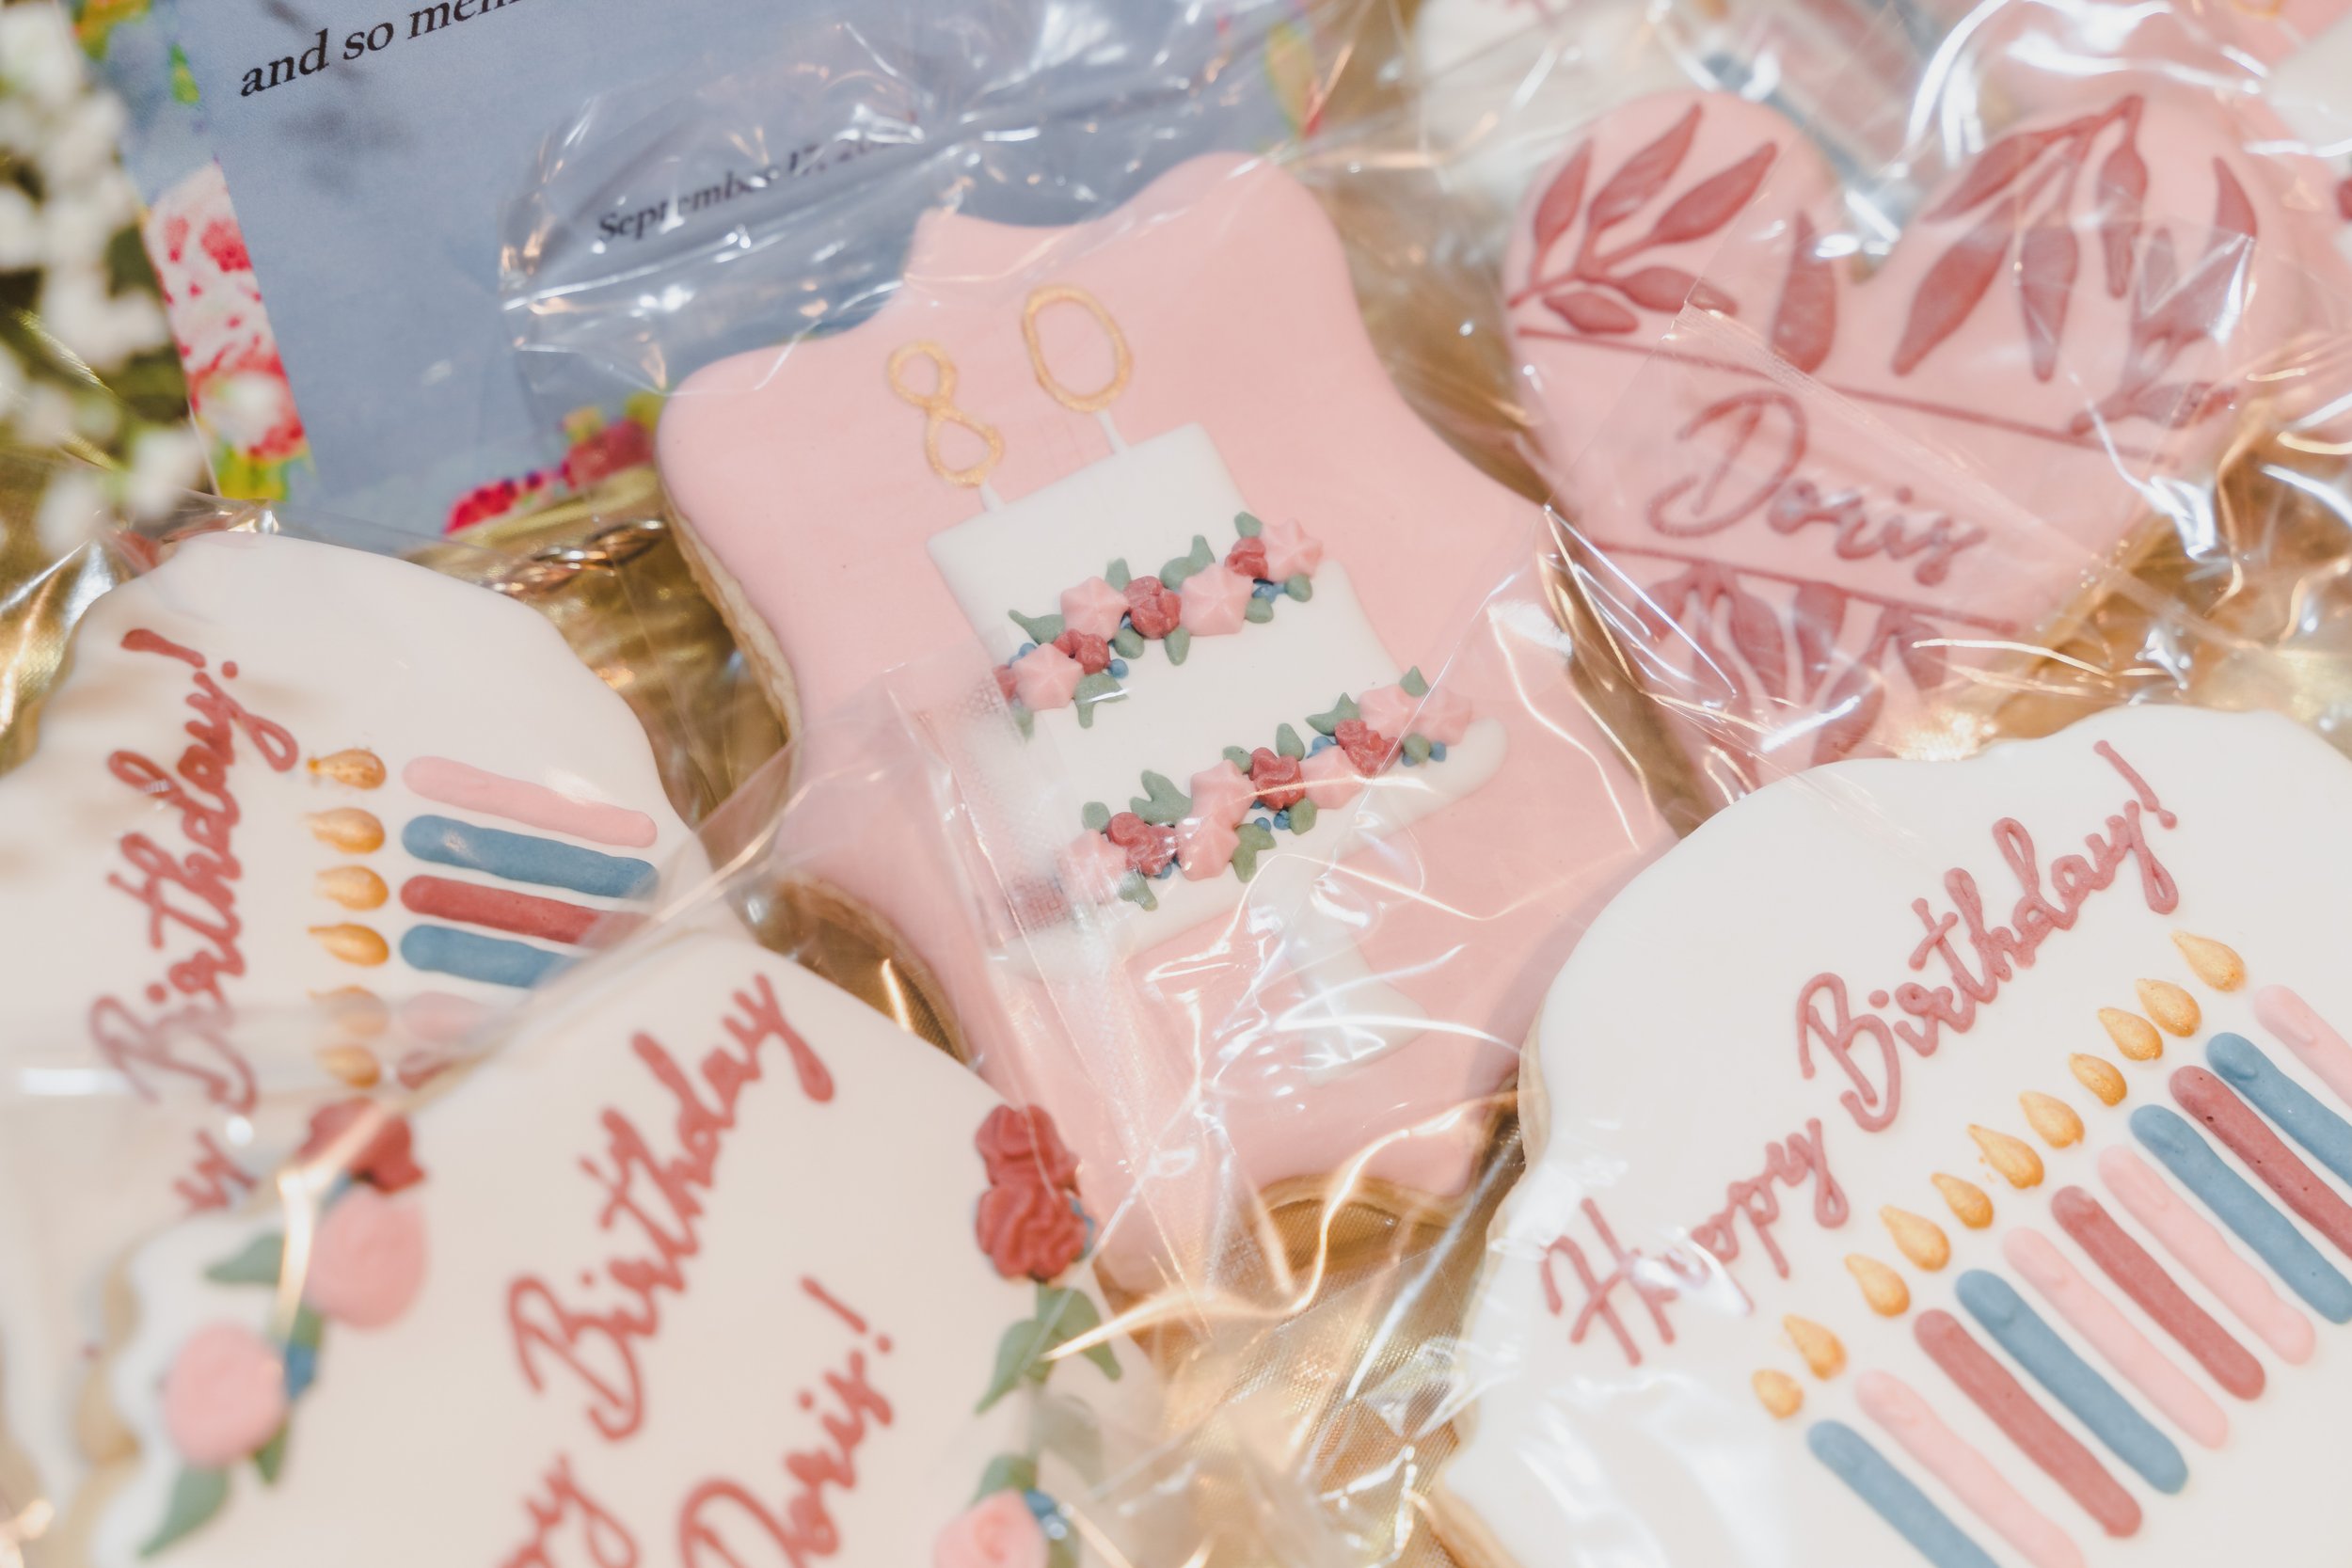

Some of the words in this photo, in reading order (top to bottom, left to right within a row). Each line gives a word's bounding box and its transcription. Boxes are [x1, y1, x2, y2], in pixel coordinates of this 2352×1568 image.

[241, 28, 329, 97] and
[342, 23, 394, 60] so
[598, 166, 782, 242] Septembr
[887, 284, 1132, 487] 80
[1645, 389, 1988, 587] Doris
[87, 627, 299, 1117] Birthday!
[1796, 740, 2178, 1131] Birthday!
[507, 974, 834, 1441] Birthday
